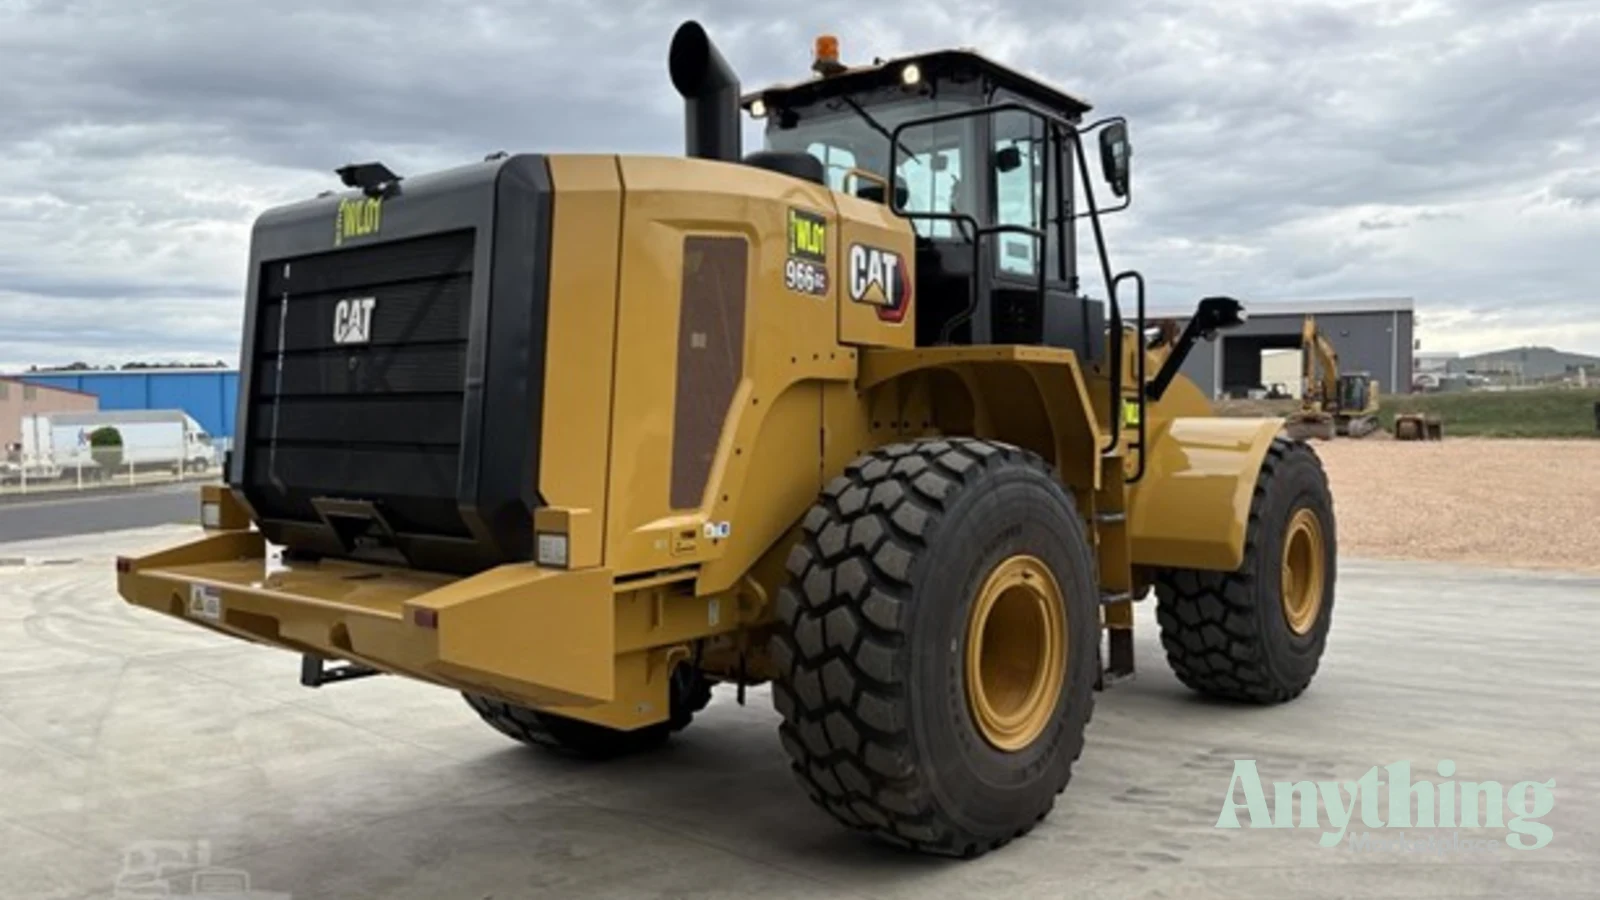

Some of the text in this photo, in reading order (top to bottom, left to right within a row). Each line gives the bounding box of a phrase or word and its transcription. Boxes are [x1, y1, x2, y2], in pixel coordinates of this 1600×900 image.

[785, 259, 815, 291] 966
[850, 243, 898, 305] CAT
[333, 296, 377, 344] CAT
